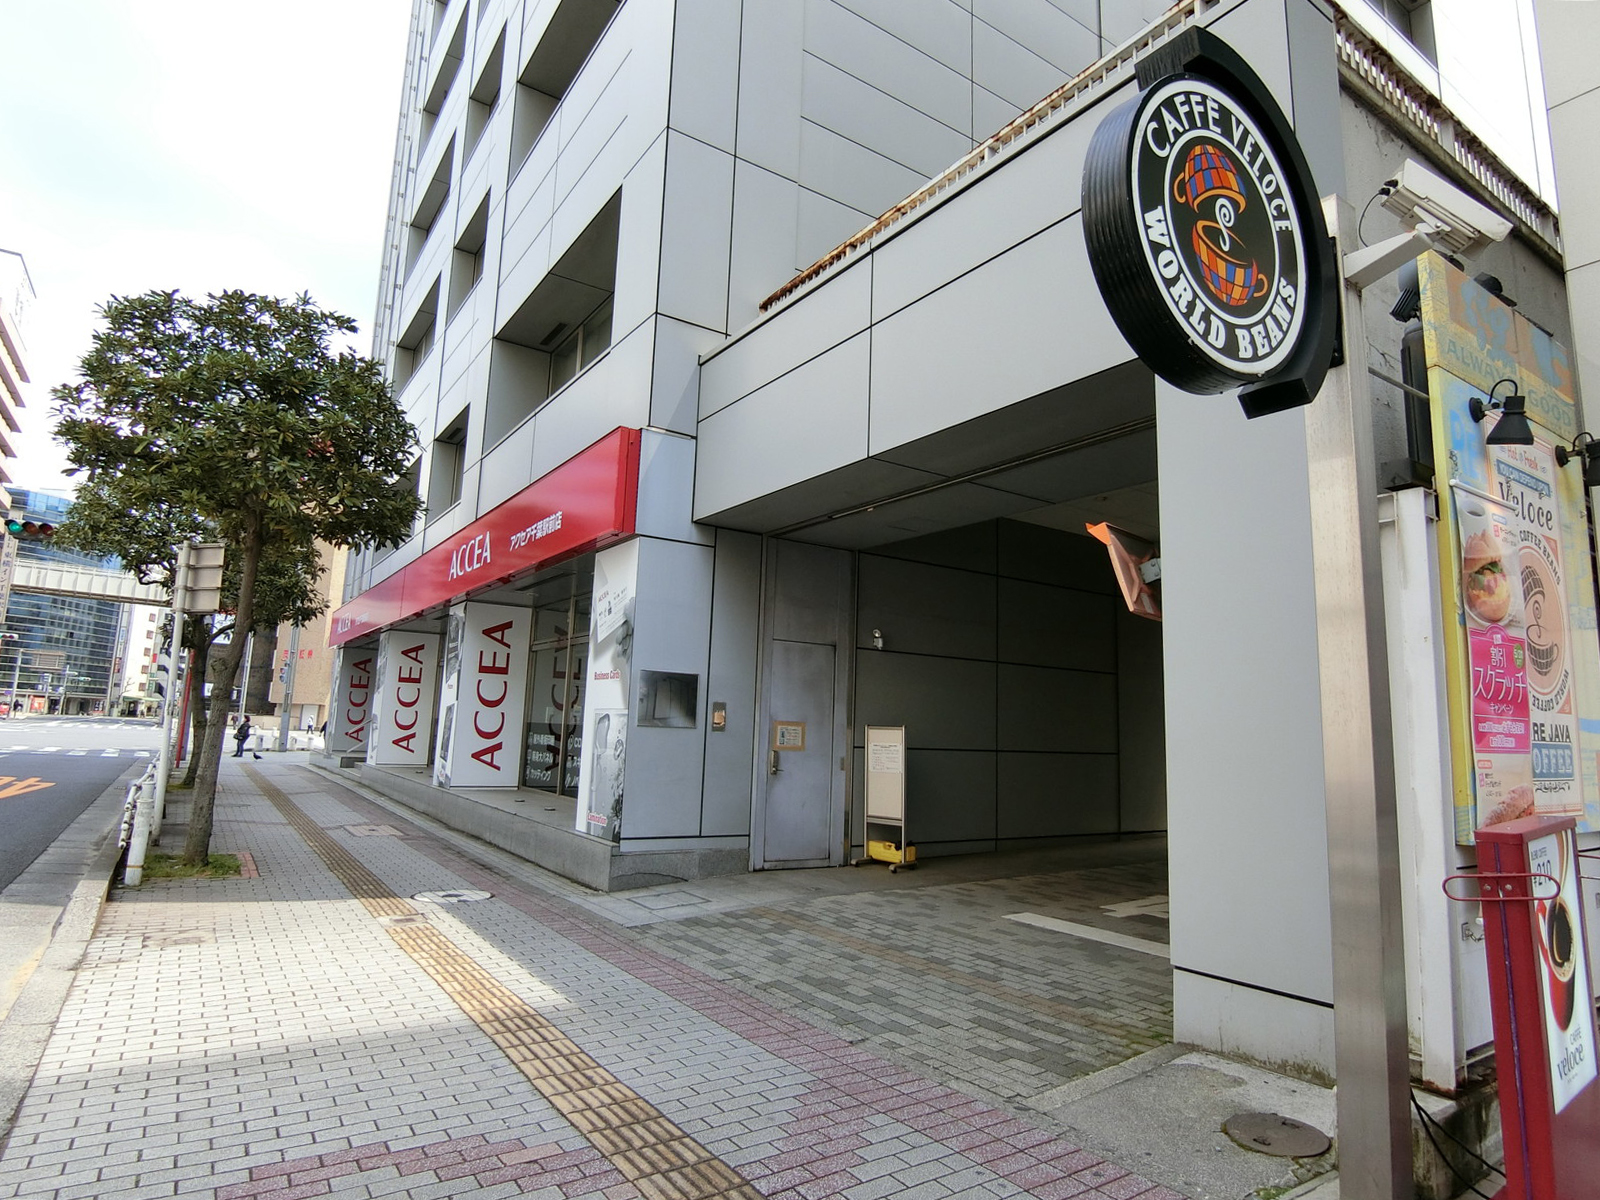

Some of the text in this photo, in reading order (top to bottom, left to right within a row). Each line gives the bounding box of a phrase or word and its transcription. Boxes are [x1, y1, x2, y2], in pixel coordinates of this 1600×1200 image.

[1231, 115, 1292, 232] VELOCE
[1144, 206, 1297, 359] WORLD BEANS
[1527, 388, 1571, 427] GOOD
[448, 530, 491, 582] ACCEA
[1519, 530, 1542, 550] COFFEE
[1490, 646, 1507, 668] 割引
[344, 657, 373, 743] ACCEA
[391, 643, 426, 754] ACCEA
[470, 620, 514, 771] ACCEA
[1474, 665, 1527, 703] スクラッチ
[1533, 722, 1546, 742] RE
[1549, 724, 1572, 743] JAVA
[1533, 747, 1573, 774] OFFEE
[1557, 1043, 1584, 1080] veloce
